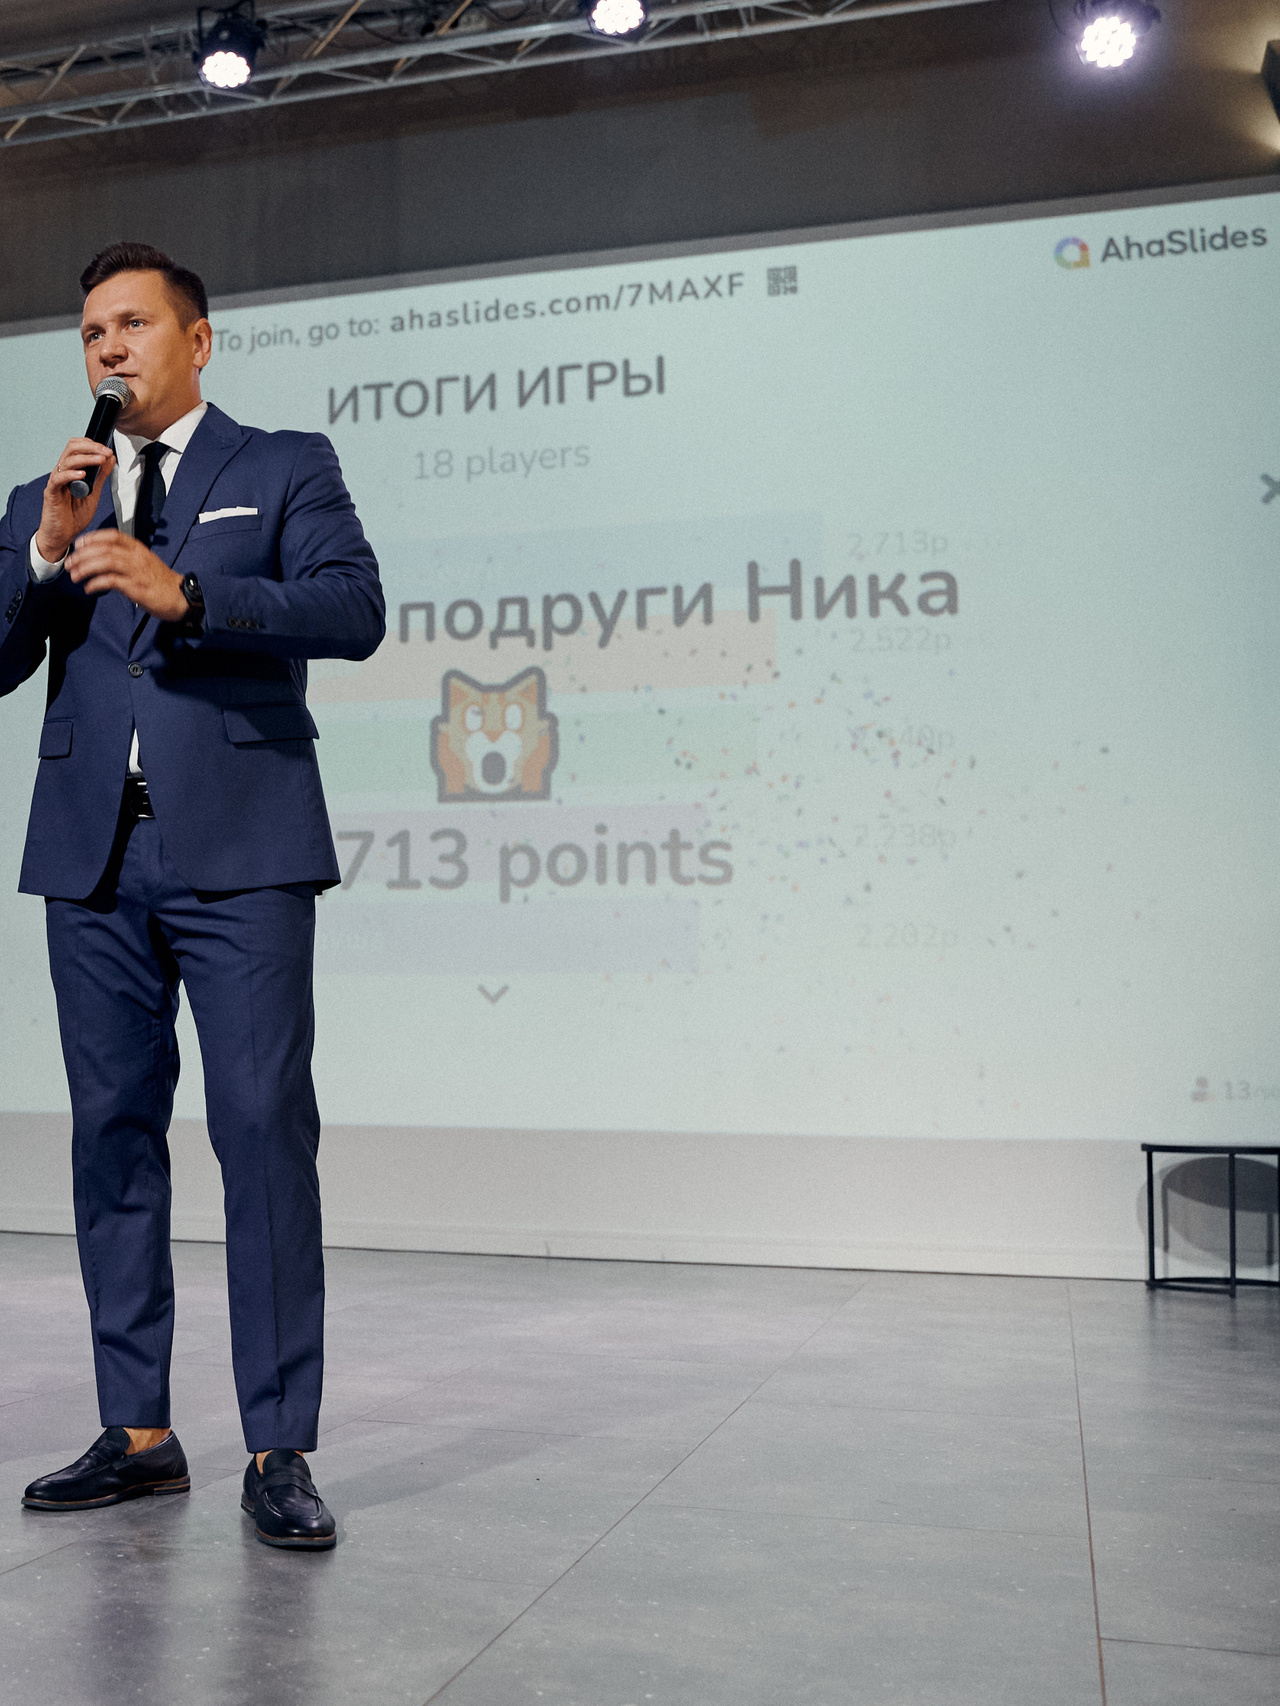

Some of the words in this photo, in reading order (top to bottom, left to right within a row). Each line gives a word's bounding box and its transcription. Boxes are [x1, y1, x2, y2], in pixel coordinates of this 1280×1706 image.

[1101, 224, 1268, 262] AhaSlides
[213, 329, 242, 351] To
[248, 325, 300, 355] join,
[308, 323, 340, 347] go
[348, 317, 380, 338] to:
[389, 272, 745, 333] ahaslides.com/7MAXF
[327, 371, 496, 425] ИТОГИ
[518, 355, 665, 409] ИГРЫ
[415, 449, 454, 480] 18
[466, 441, 591, 482] players
[398, 582, 714, 651] подруги
[746, 558, 960, 623] Ника
[321, 827, 469, 893] 713
[498, 823, 734, 904] points
